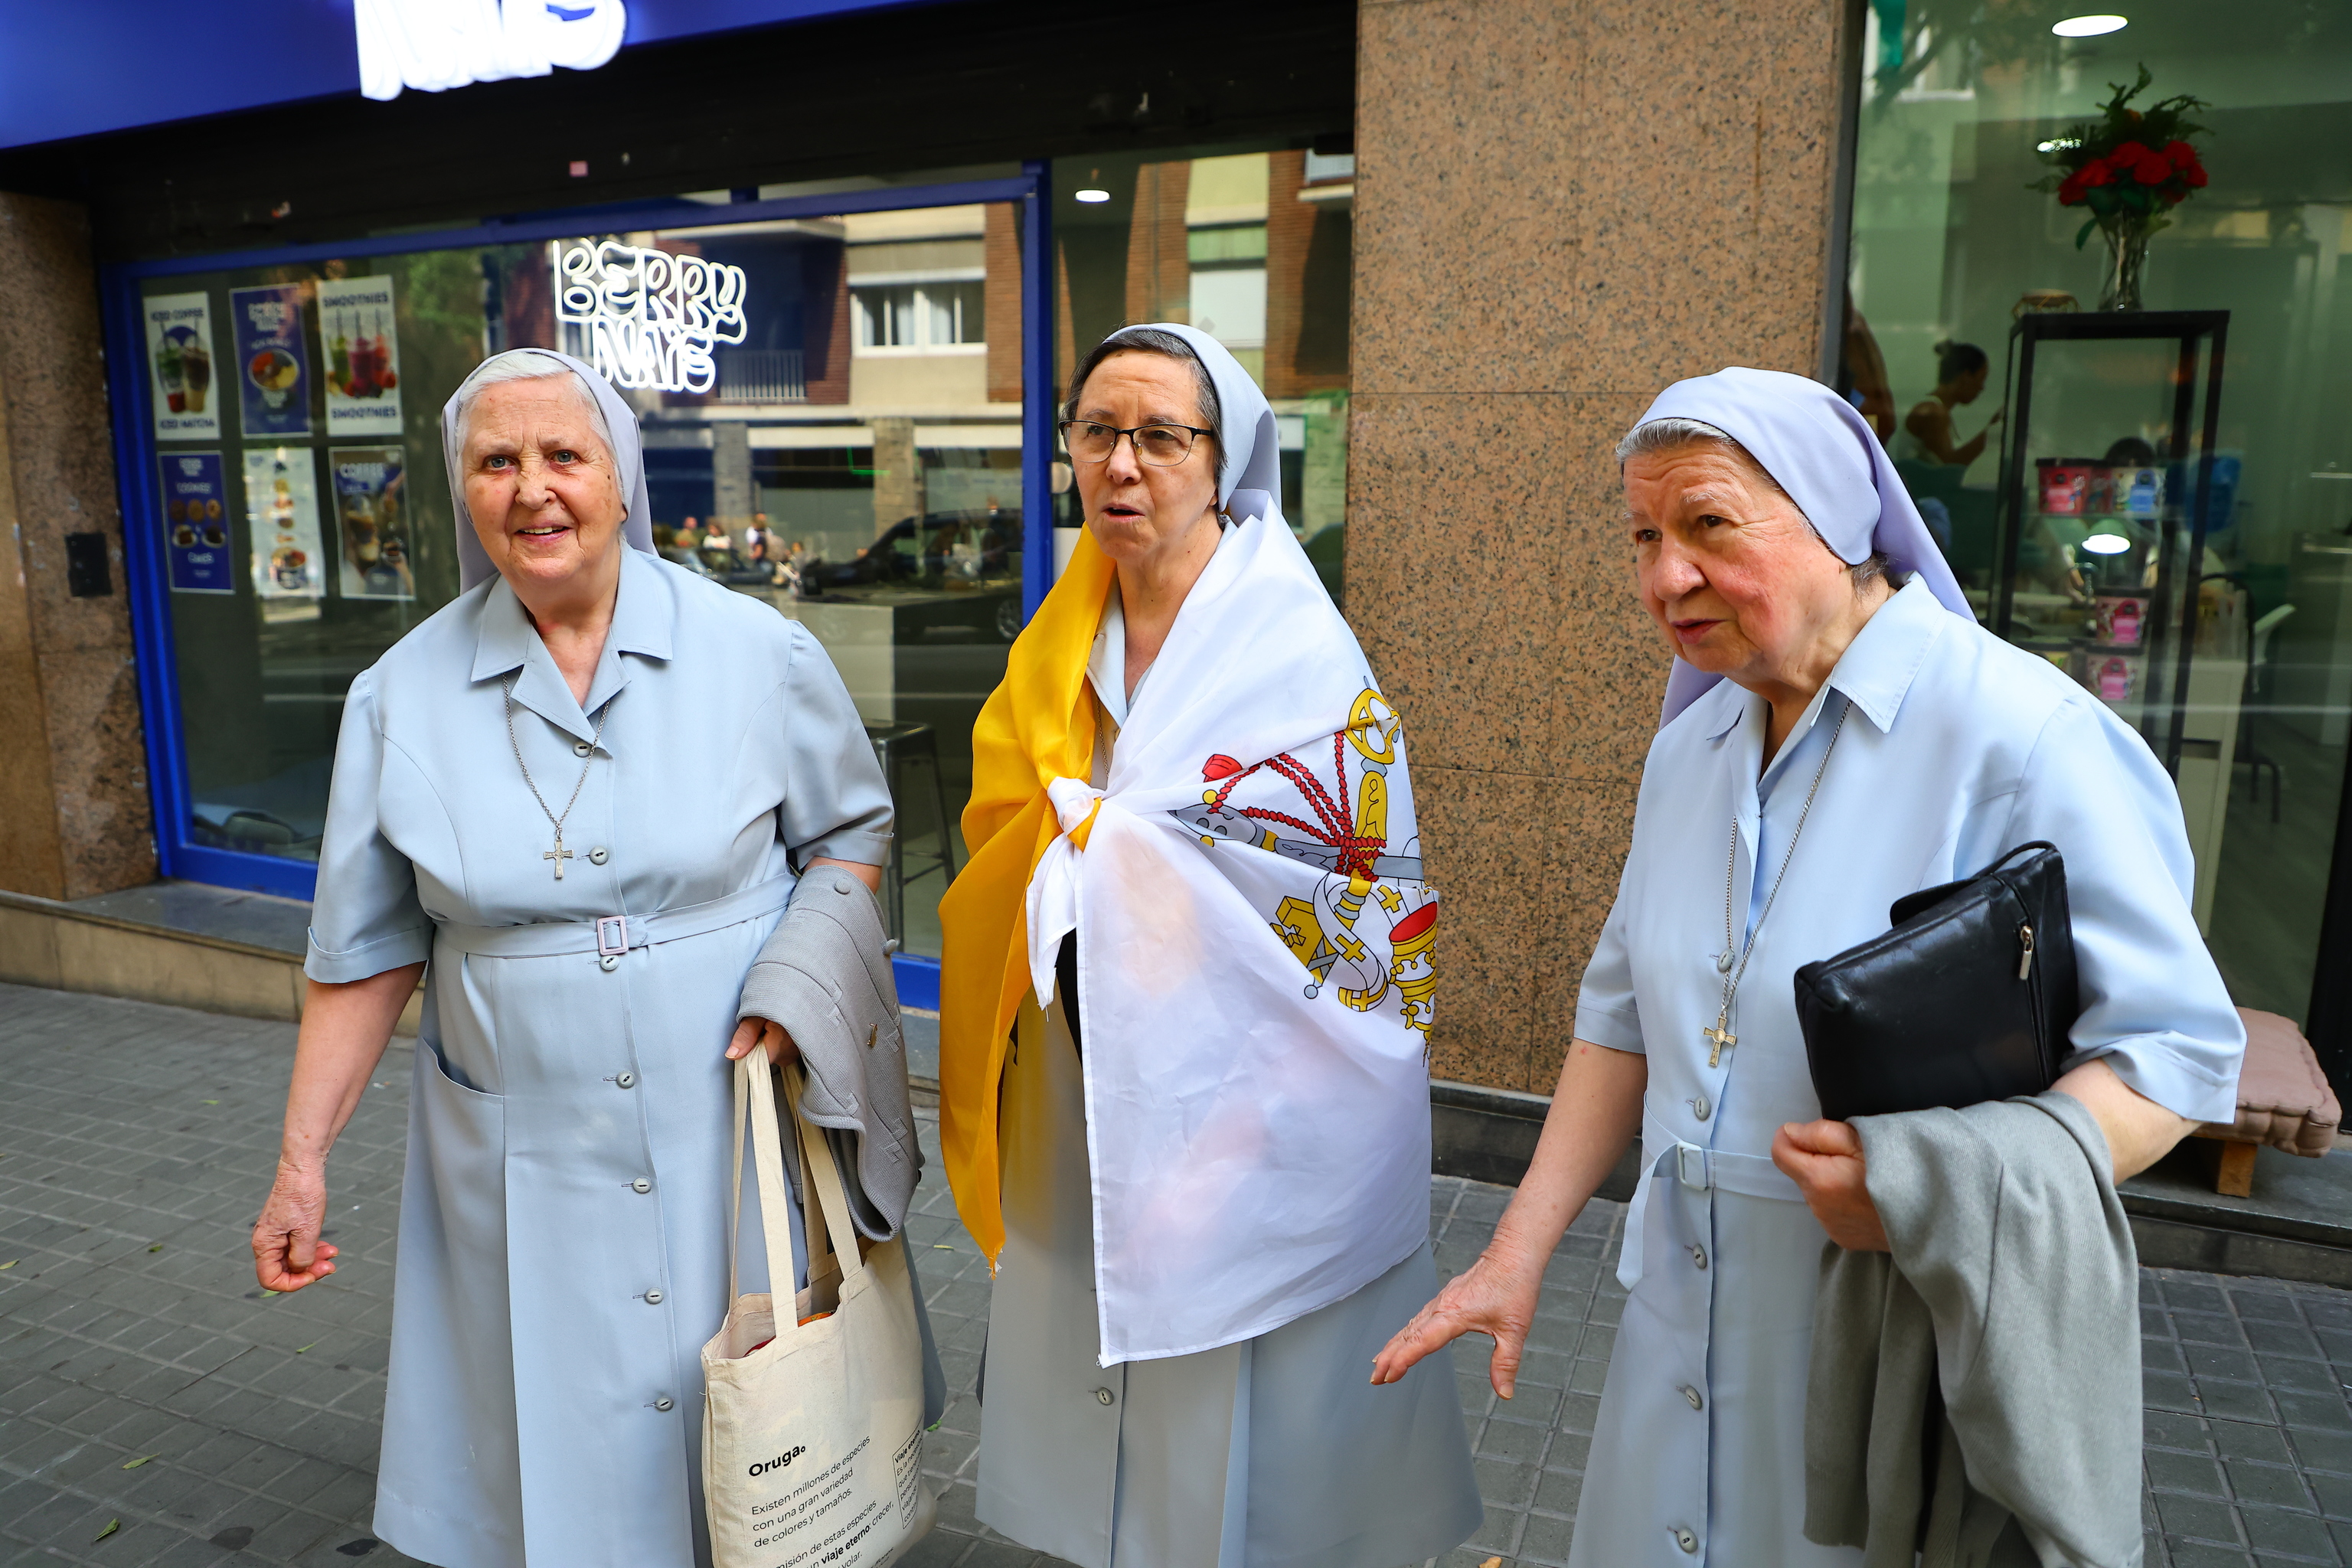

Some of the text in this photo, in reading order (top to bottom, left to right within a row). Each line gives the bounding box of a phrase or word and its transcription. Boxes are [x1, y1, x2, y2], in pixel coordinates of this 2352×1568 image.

[552, 237, 747, 345] BERRY
[332, 406, 397, 419] SMOOTHIES
[752, 1435, 871, 1515] Existen millones de especies
[894, 1449, 908, 1463] Viaje
[897, 1466, 903, 1476] Es
[899, 1475, 908, 1488] que
[753, 1466, 854, 1531] con una gran variedad
[754, 1488, 853, 1547] de colores y tamaños.
[809, 1543, 822, 1555] de
[823, 1527, 846, 1547] estas
[847, 1499, 877, 1531] especies
[821, 1544, 844, 1564] viaje
[845, 1523, 872, 1550] eterno:
[871, 1501, 894, 1527] crecer,
[841, 1550, 863, 1568] volar.
